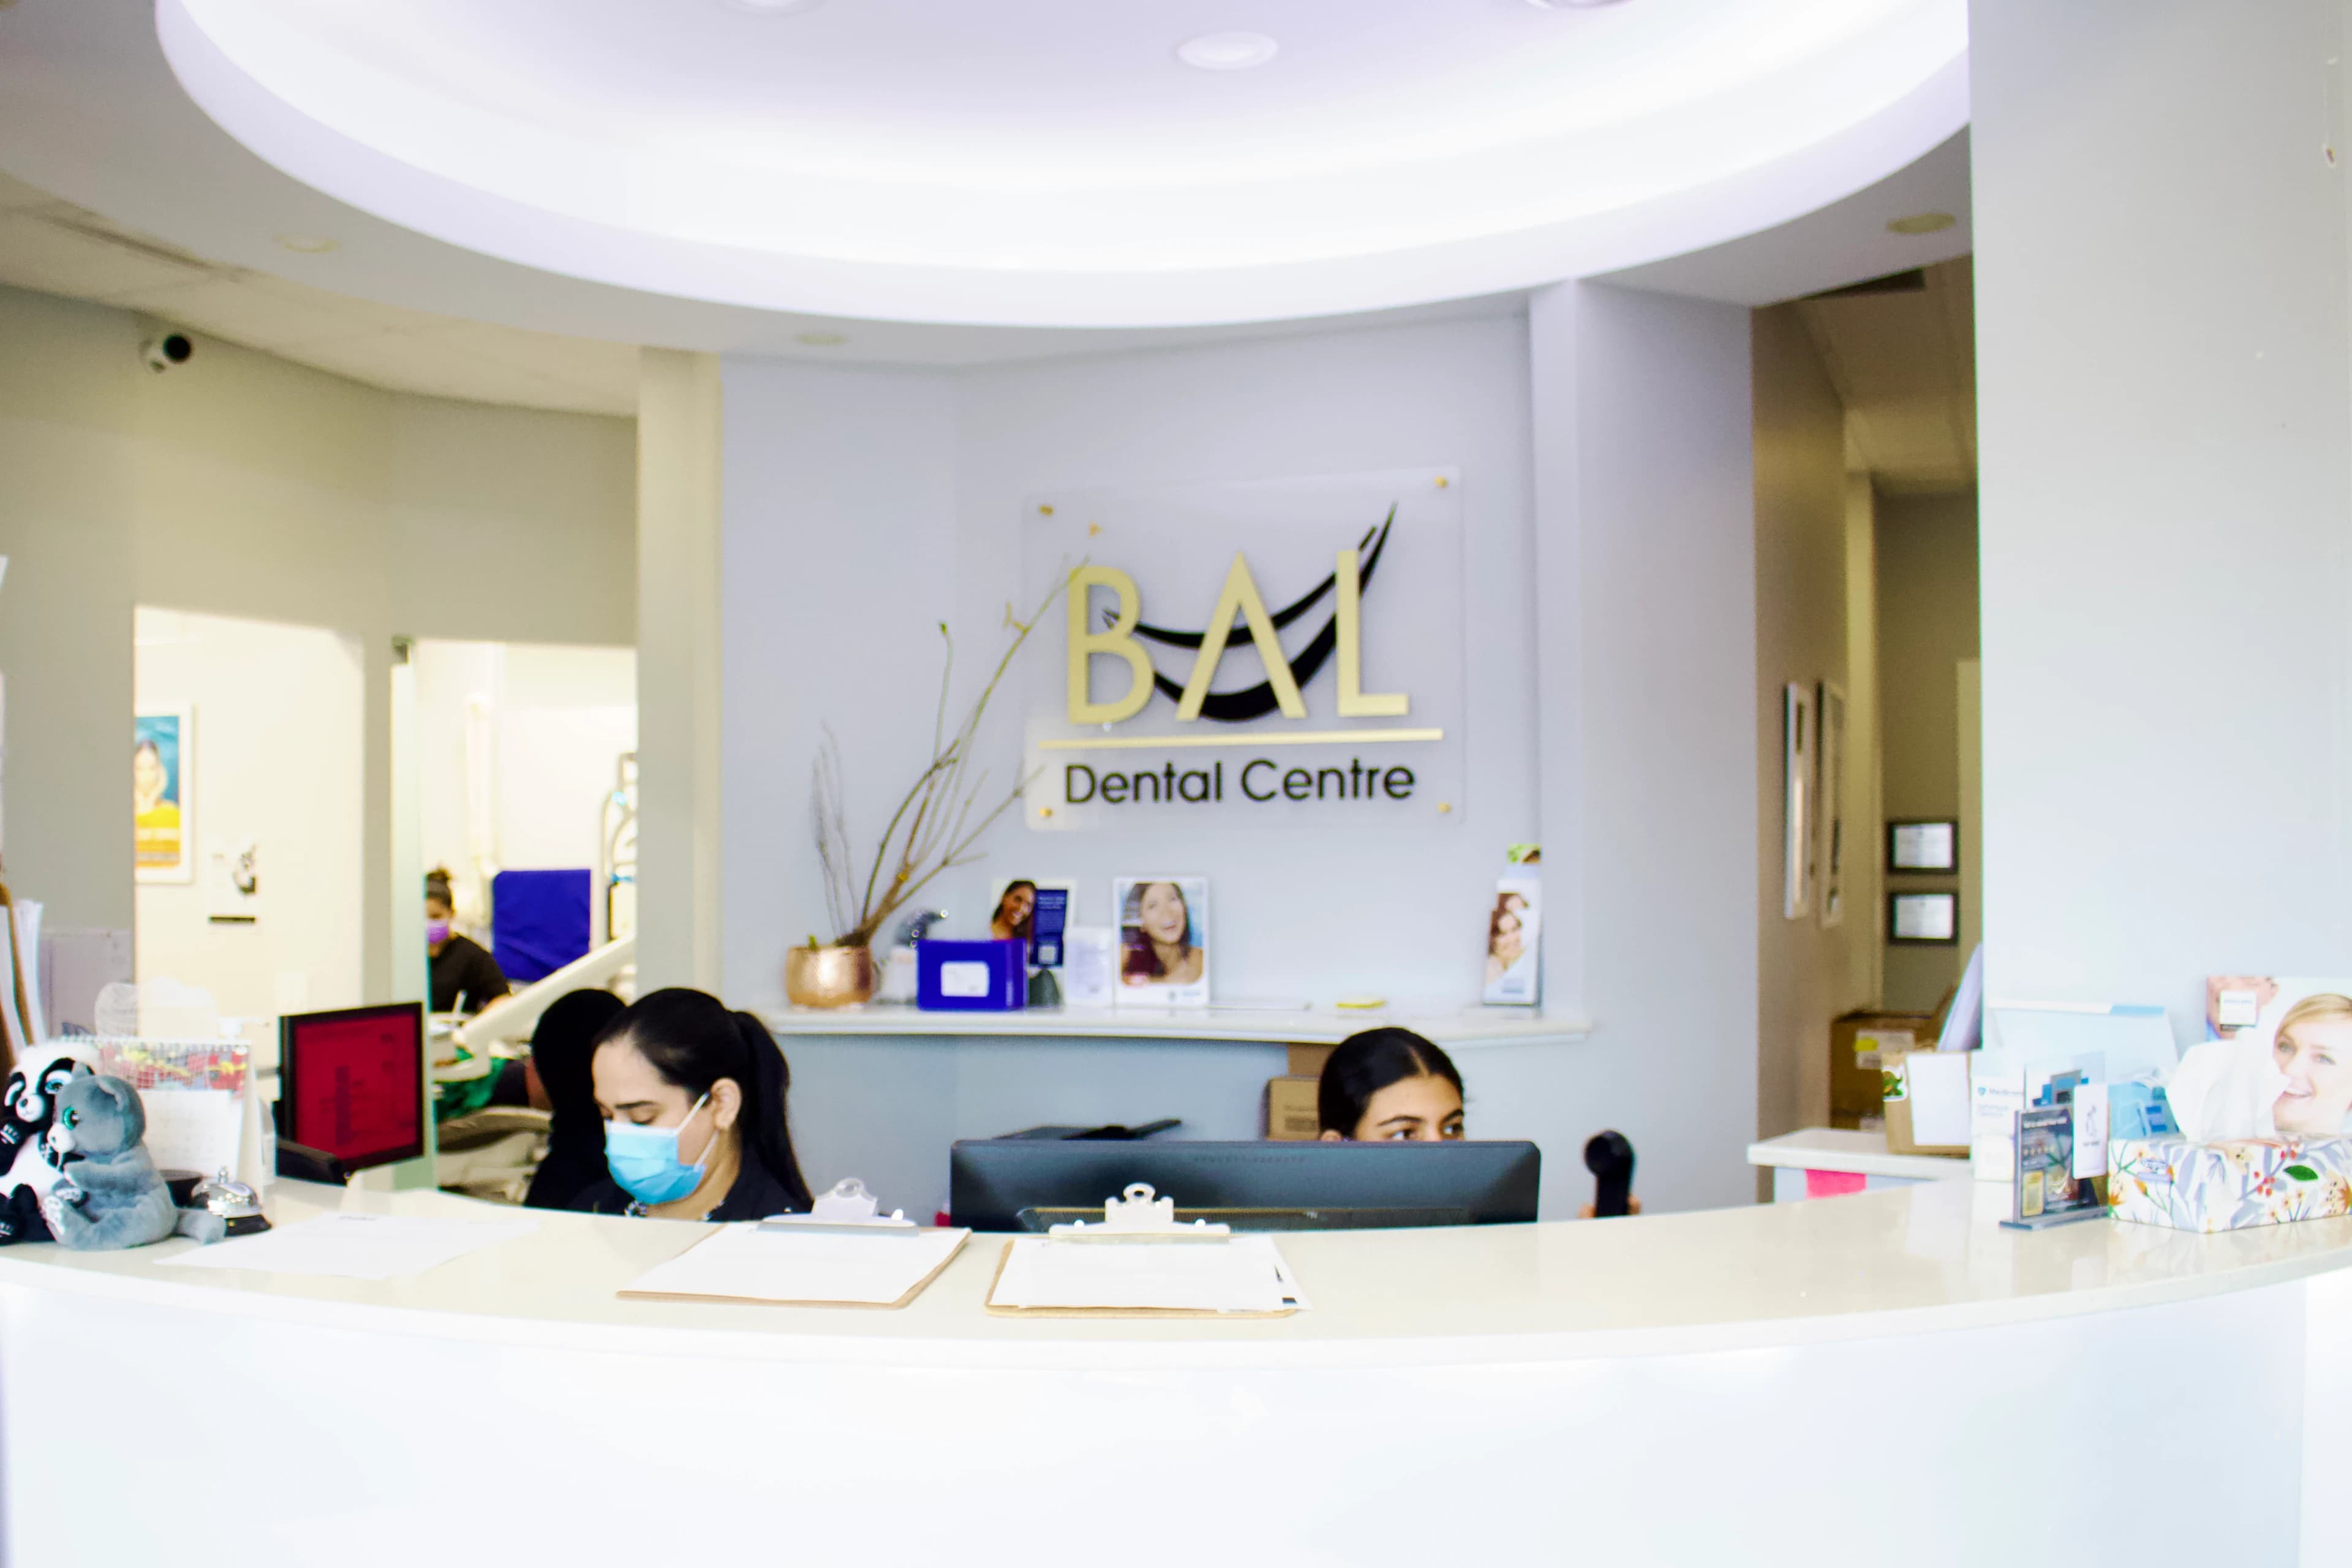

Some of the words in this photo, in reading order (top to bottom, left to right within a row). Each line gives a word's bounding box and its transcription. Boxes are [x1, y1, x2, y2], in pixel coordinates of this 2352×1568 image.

[1068, 551, 1409, 725] BAL
[1066, 761, 1223, 804] Dental
[1240, 758, 1416, 802] Centre
